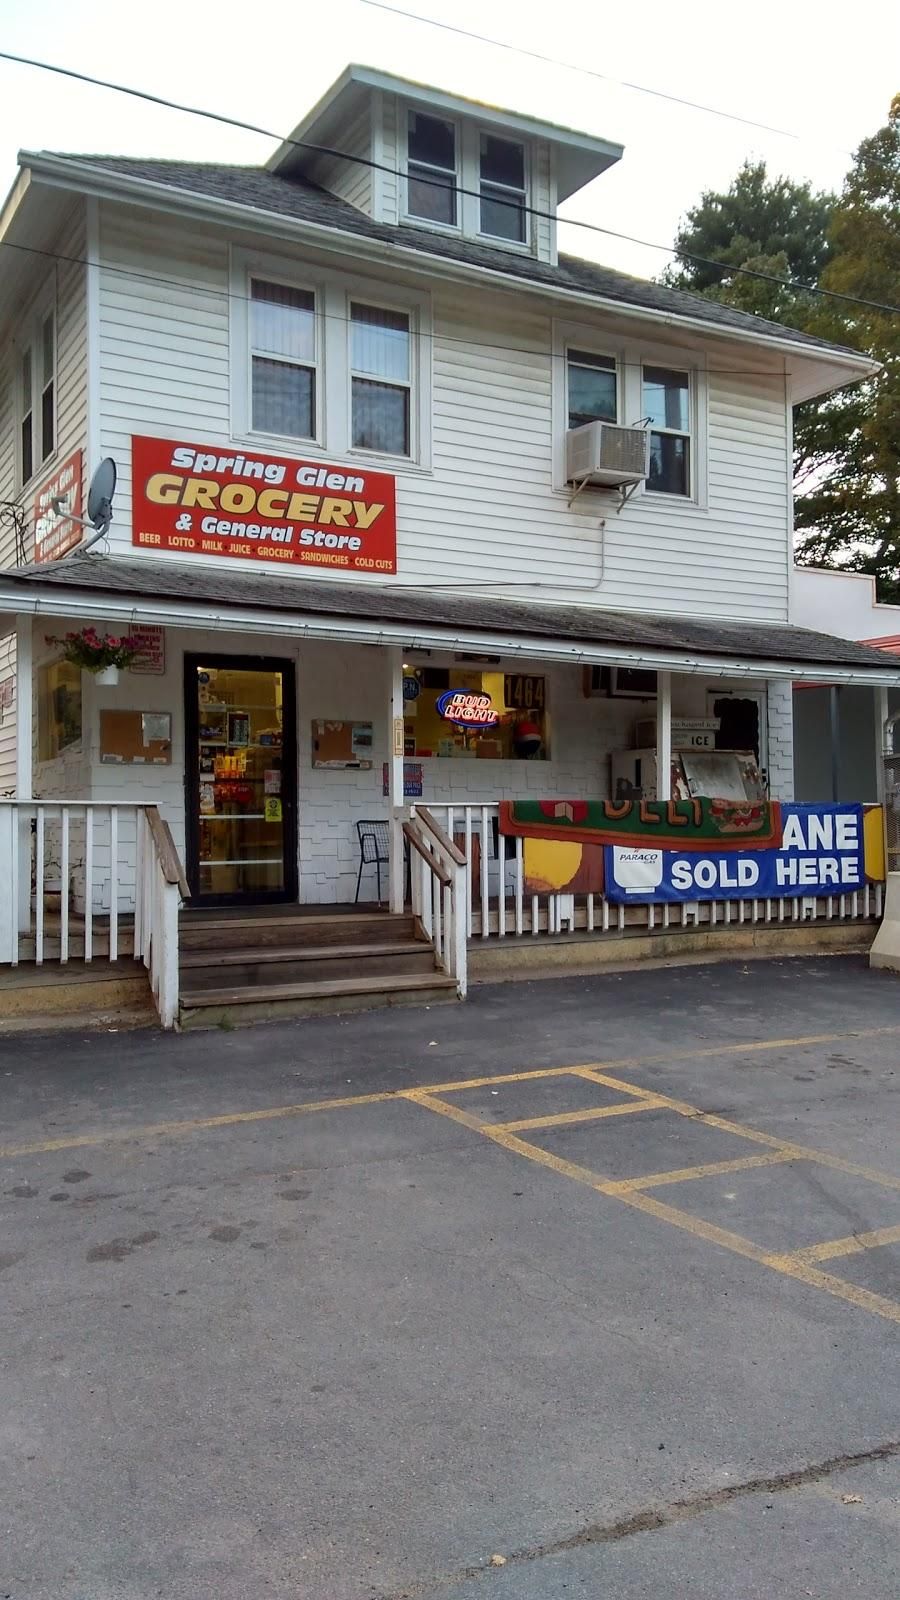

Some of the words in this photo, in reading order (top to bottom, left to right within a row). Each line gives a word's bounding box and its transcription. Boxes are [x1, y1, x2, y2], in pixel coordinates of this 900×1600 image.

[171, 447, 287, 484] Spring
[296, 466, 365, 493] Glen
[145, 472, 385, 530] GROCERY
[175, 513, 193, 531] &
[201, 516, 294, 543] General
[299, 528, 362, 551] Store
[139, 532, 161, 544] BEER
[168, 535, 195, 548] LOTTO
[202, 539, 223, 552] MILK
[228, 542, 251, 555] JUICE
[257, 546, 294, 560] GROCERY
[300, 551, 349, 566] SANDWICHES
[354, 556, 374, 569] COLD
[375, 558, 393, 571] CUTS
[452, 694, 491, 709] BUD
[506, 678, 545, 708] 1464
[444, 705, 498, 722] LIGHT
[691, 736, 709, 746] ICE
[671, 859, 760, 890] SOLD
[775, 857, 860, 887] HERE
